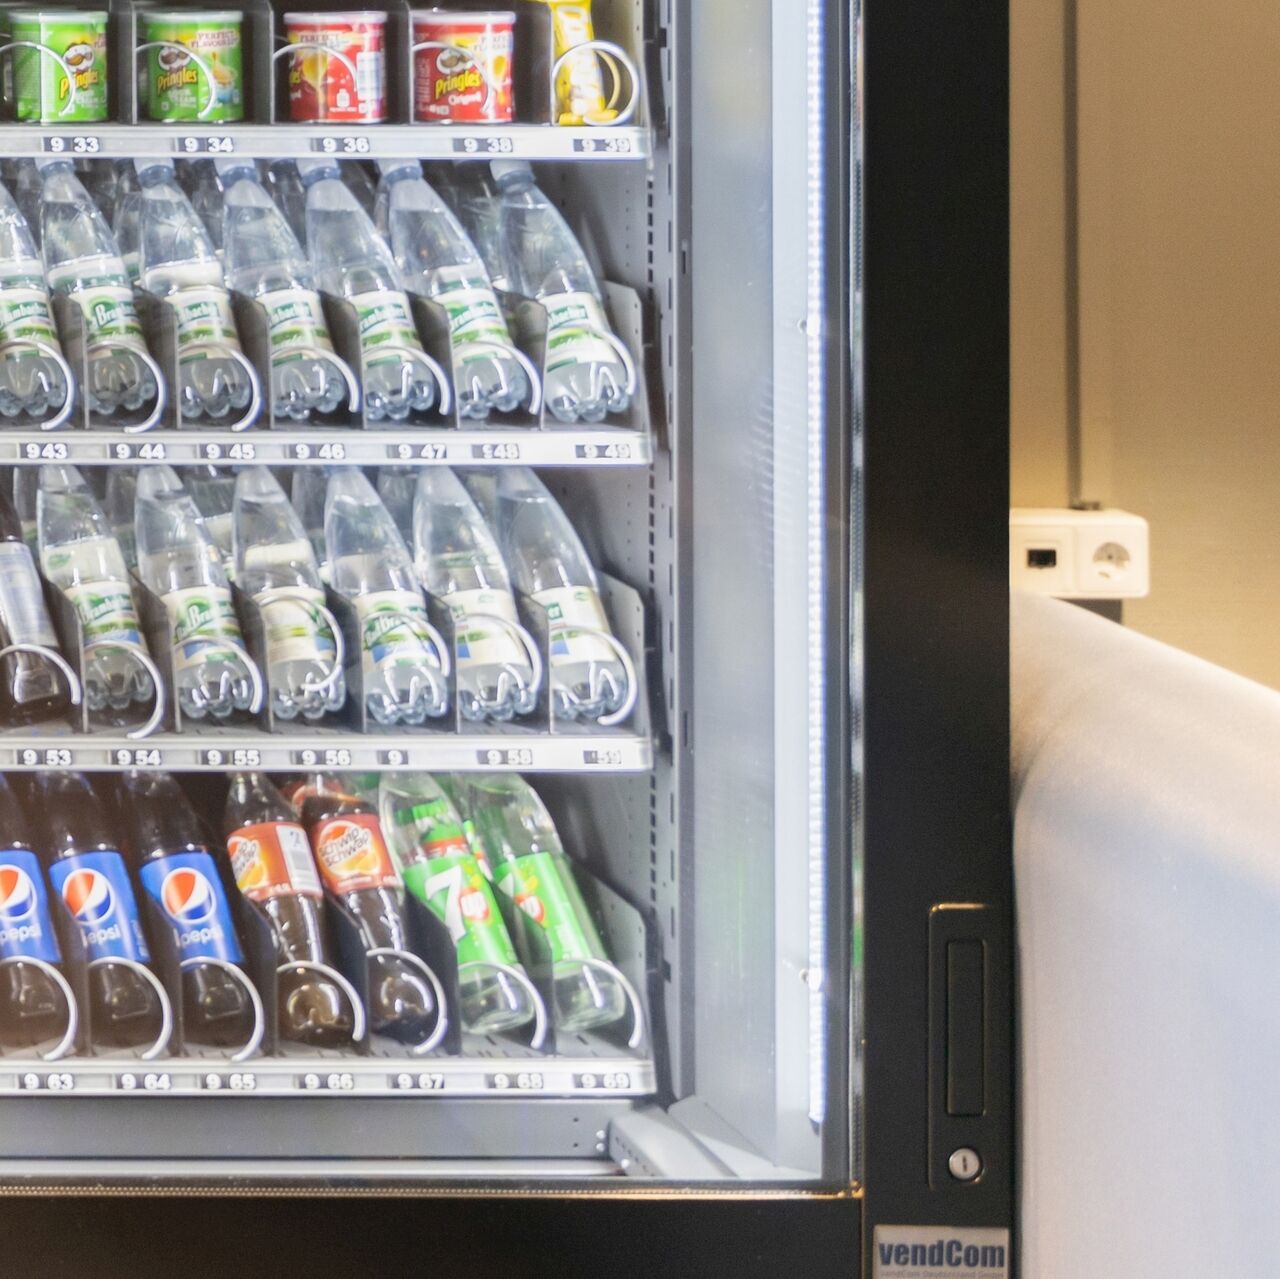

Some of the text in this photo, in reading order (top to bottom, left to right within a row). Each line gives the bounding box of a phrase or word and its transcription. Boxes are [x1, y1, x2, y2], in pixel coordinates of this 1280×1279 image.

[59, 69, 99, 100] Pingles
[157, 68, 198, 97] Pringles
[435, 70, 481, 99] Pringles
[426, 864, 466, 945] 7
[86, 924, 120, 944] epsi
[880, 1239, 1005, 1268] vendCom
